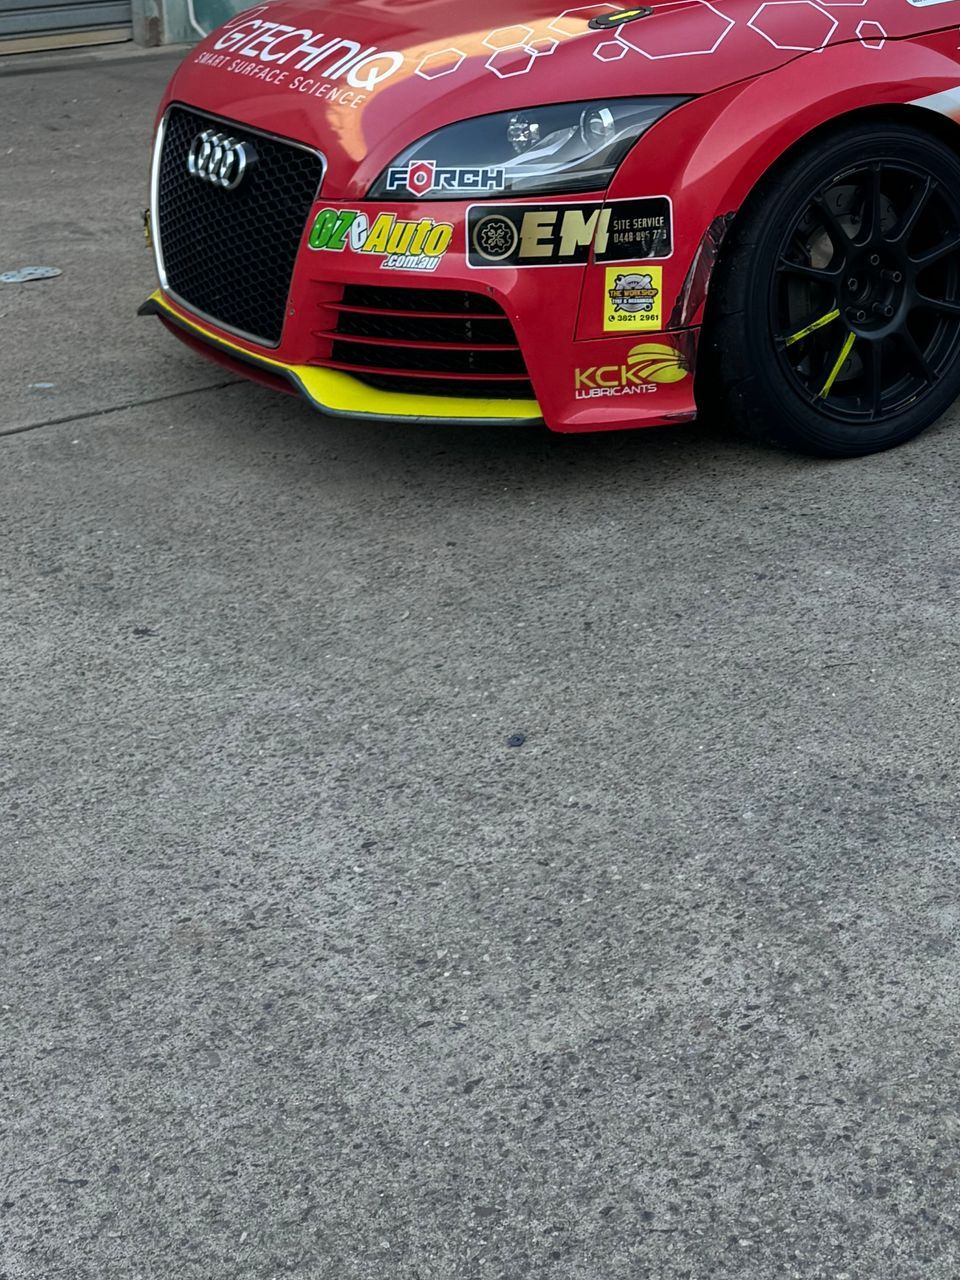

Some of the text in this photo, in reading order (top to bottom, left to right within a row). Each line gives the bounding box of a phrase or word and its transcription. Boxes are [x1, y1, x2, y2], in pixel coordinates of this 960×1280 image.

[213, 20, 404, 92] GTECHNIQ
[194, 52, 367, 109] SMART SURFACE SCIENCE
[519, 208, 612, 257] EM
[613, 216, 665, 231] SITE SERVICE
[382, 254, 440, 270] .com.au
[575, 361, 652, 389] KCK
[575, 384, 657, 400] LUBRICANTS
